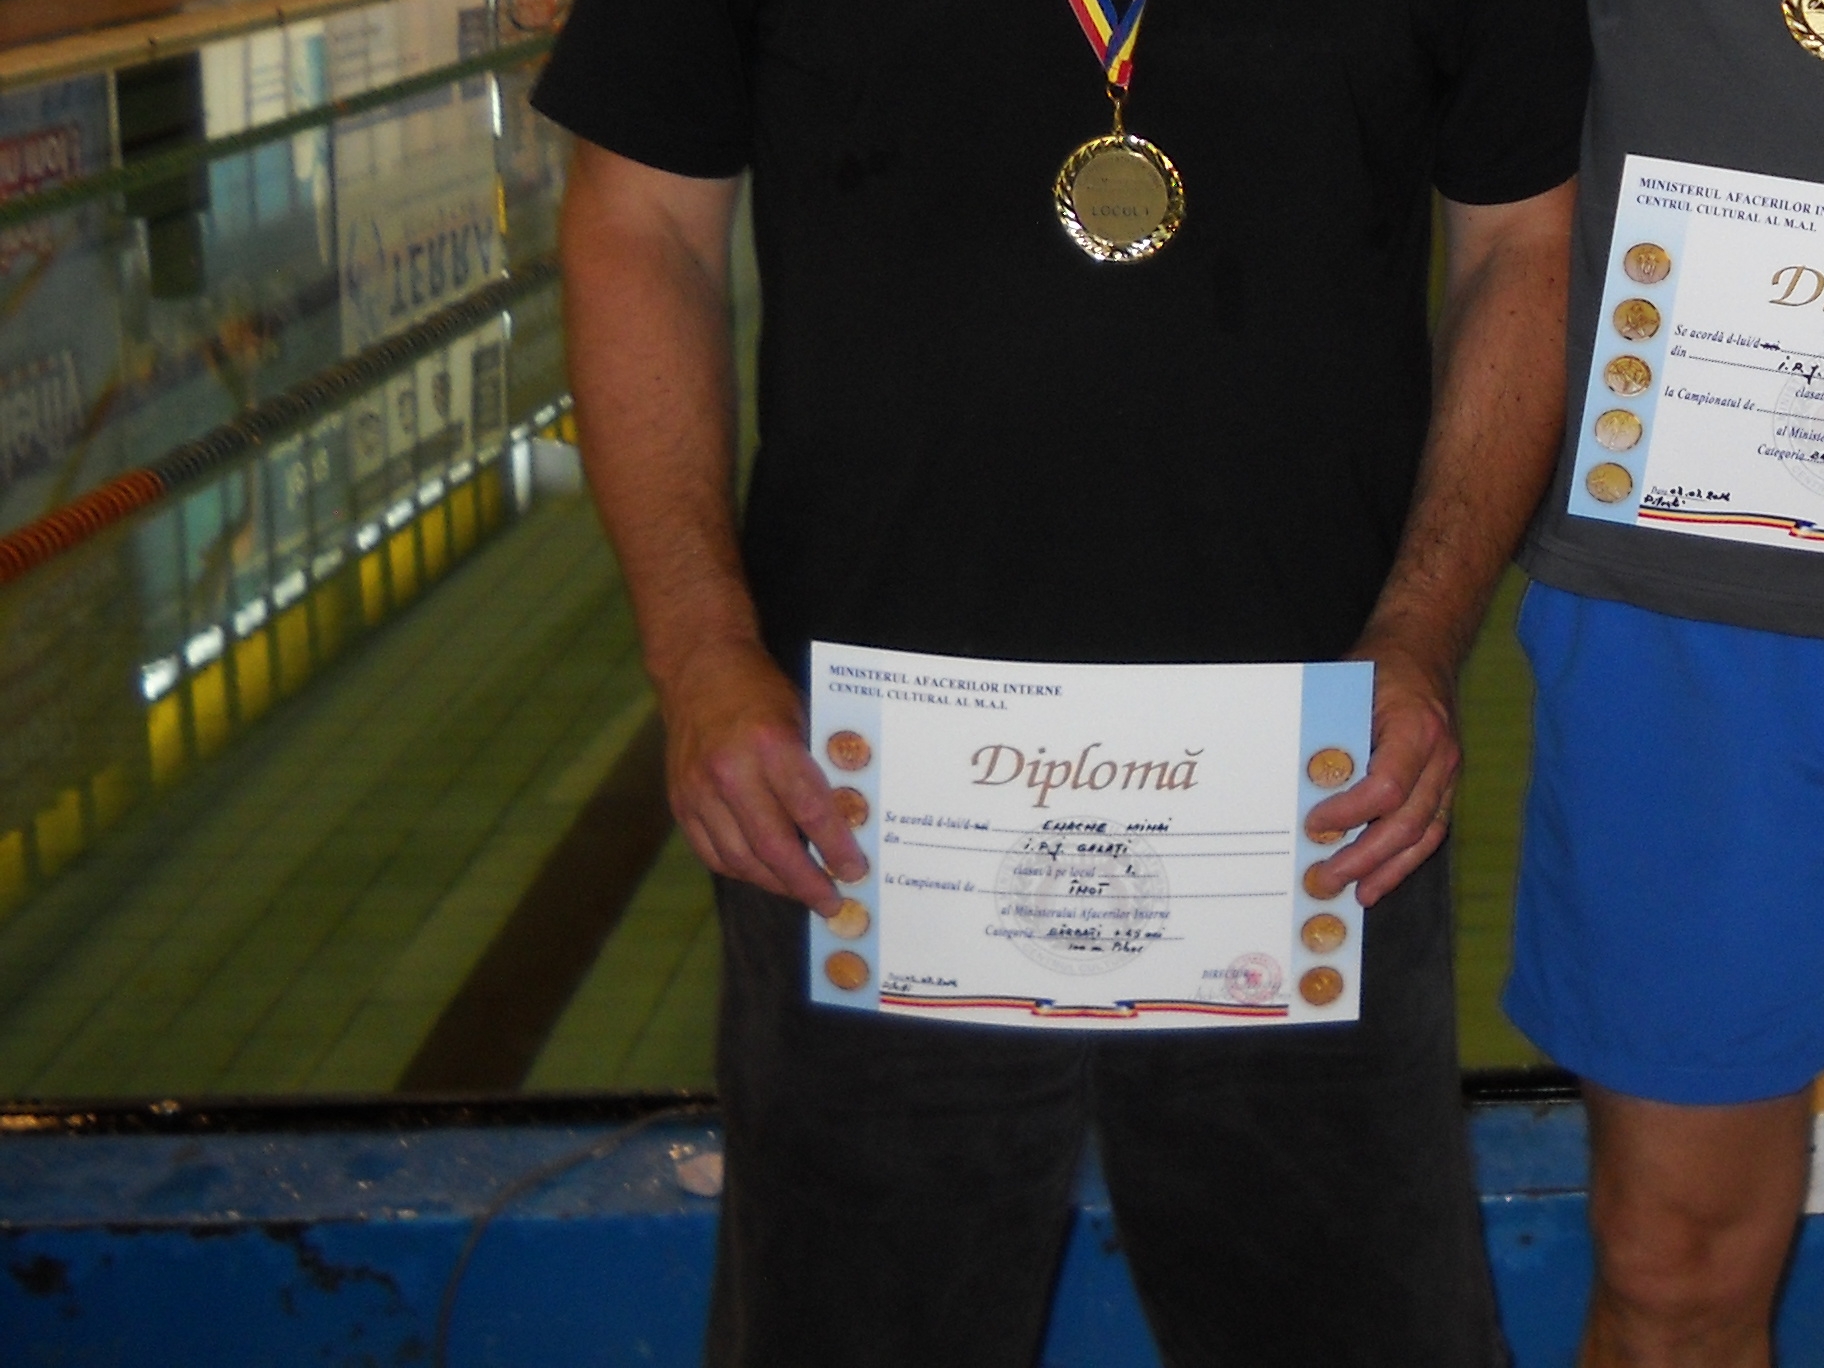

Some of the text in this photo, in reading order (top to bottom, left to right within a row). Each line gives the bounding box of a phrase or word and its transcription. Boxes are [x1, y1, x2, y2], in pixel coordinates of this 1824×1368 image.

[1640, 177, 1721, 200] MINISTERUL
[1725, 192, 1811, 214] AFACERILOR
[1092, 205, 1138, 216] LOCUL
[1636, 194, 1817, 232] CENTRUL CULTURAL AL M.A.I.
[1675, 324, 1687, 336] Se
[1689, 327, 1724, 343] acordă
[1670, 346, 1686, 358] din
[1664, 386, 1755, 411] la Campionatul de
[1776, 426, 1786, 436] al
[829, 664, 1063, 696] MINISTERUL AFACERILOR INTERNE
[829, 682, 1008, 710] CENTRUL CULTURAL AL M.A.I.
[971, 742, 1204, 808] Diplomă
[885, 811, 896, 822] Se
[900, 813, 933, 826] acordă
[884, 832, 899, 844] din
[885, 872, 975, 892] la Campionatul de
[1055, 867, 1066, 880] pe
[1001, 905, 1171, 921] al Ministerului Afacerilor Interne
